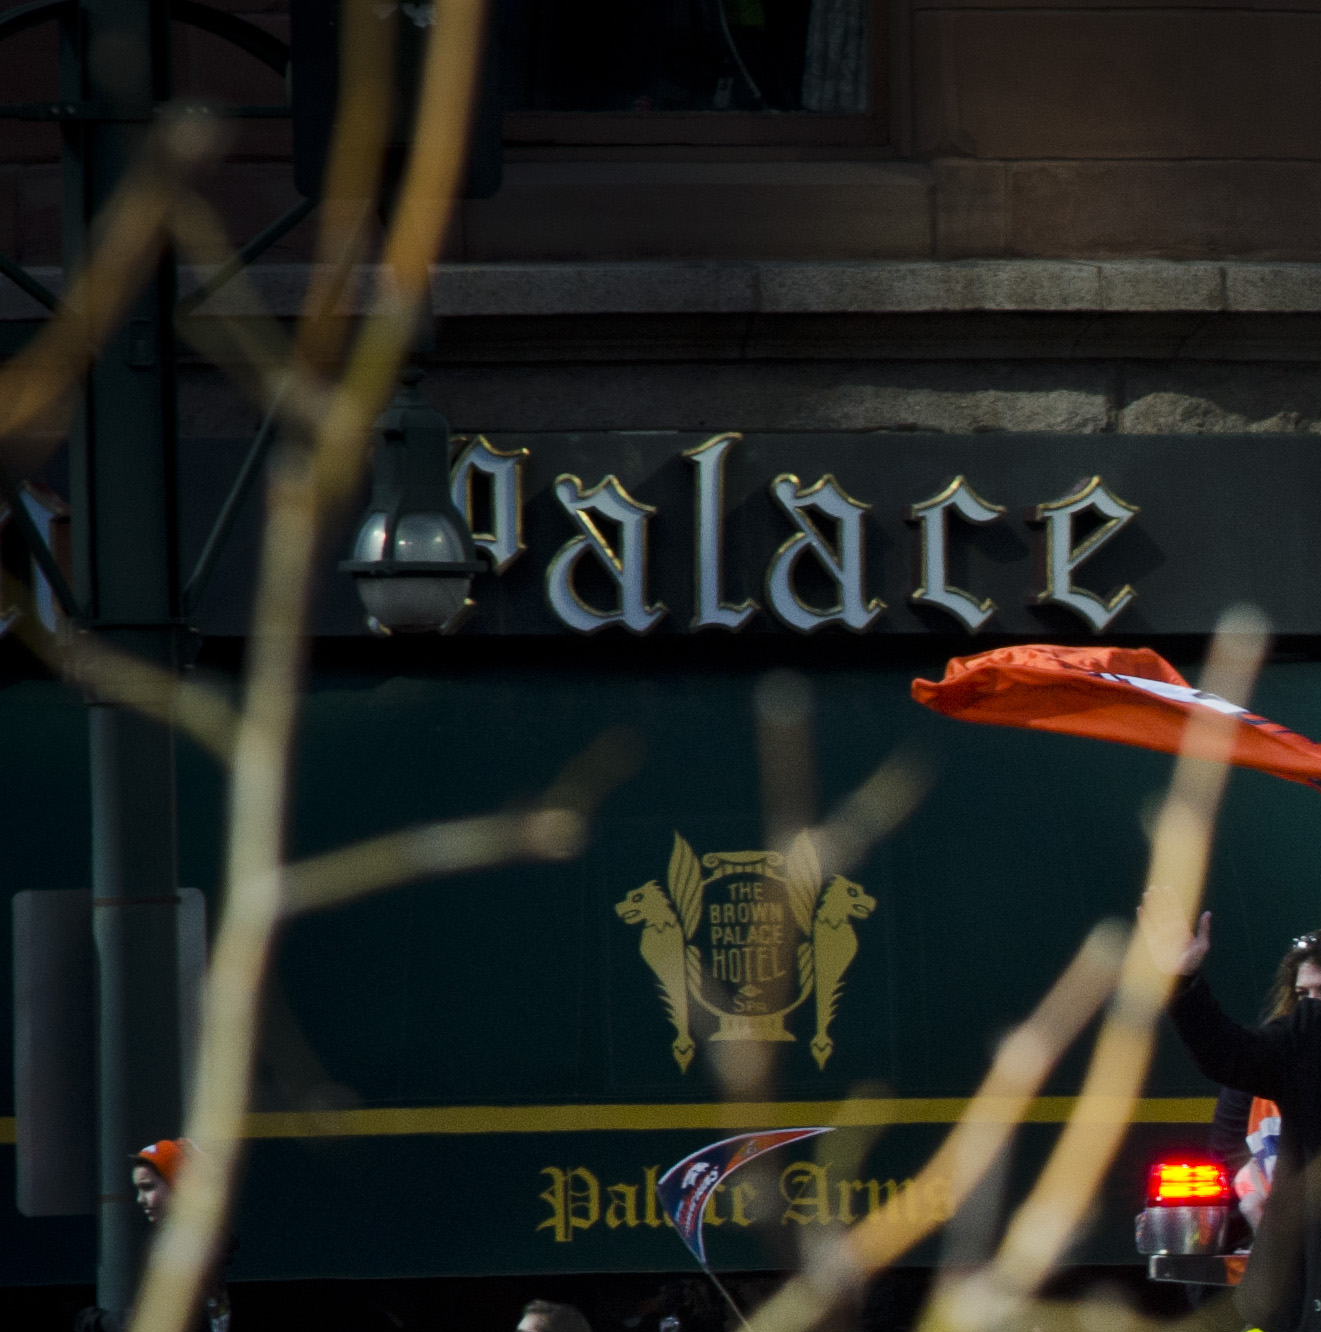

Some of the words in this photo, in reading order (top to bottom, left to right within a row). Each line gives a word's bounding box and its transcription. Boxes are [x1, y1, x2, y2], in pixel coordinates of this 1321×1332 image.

[729, 881, 763, 902] THE
[709, 902, 786, 925] BROWN
[711, 925, 784, 945] PALACE
[712, 945, 786, 983] HOTEL
[536, 1164, 757, 1241] Palce
